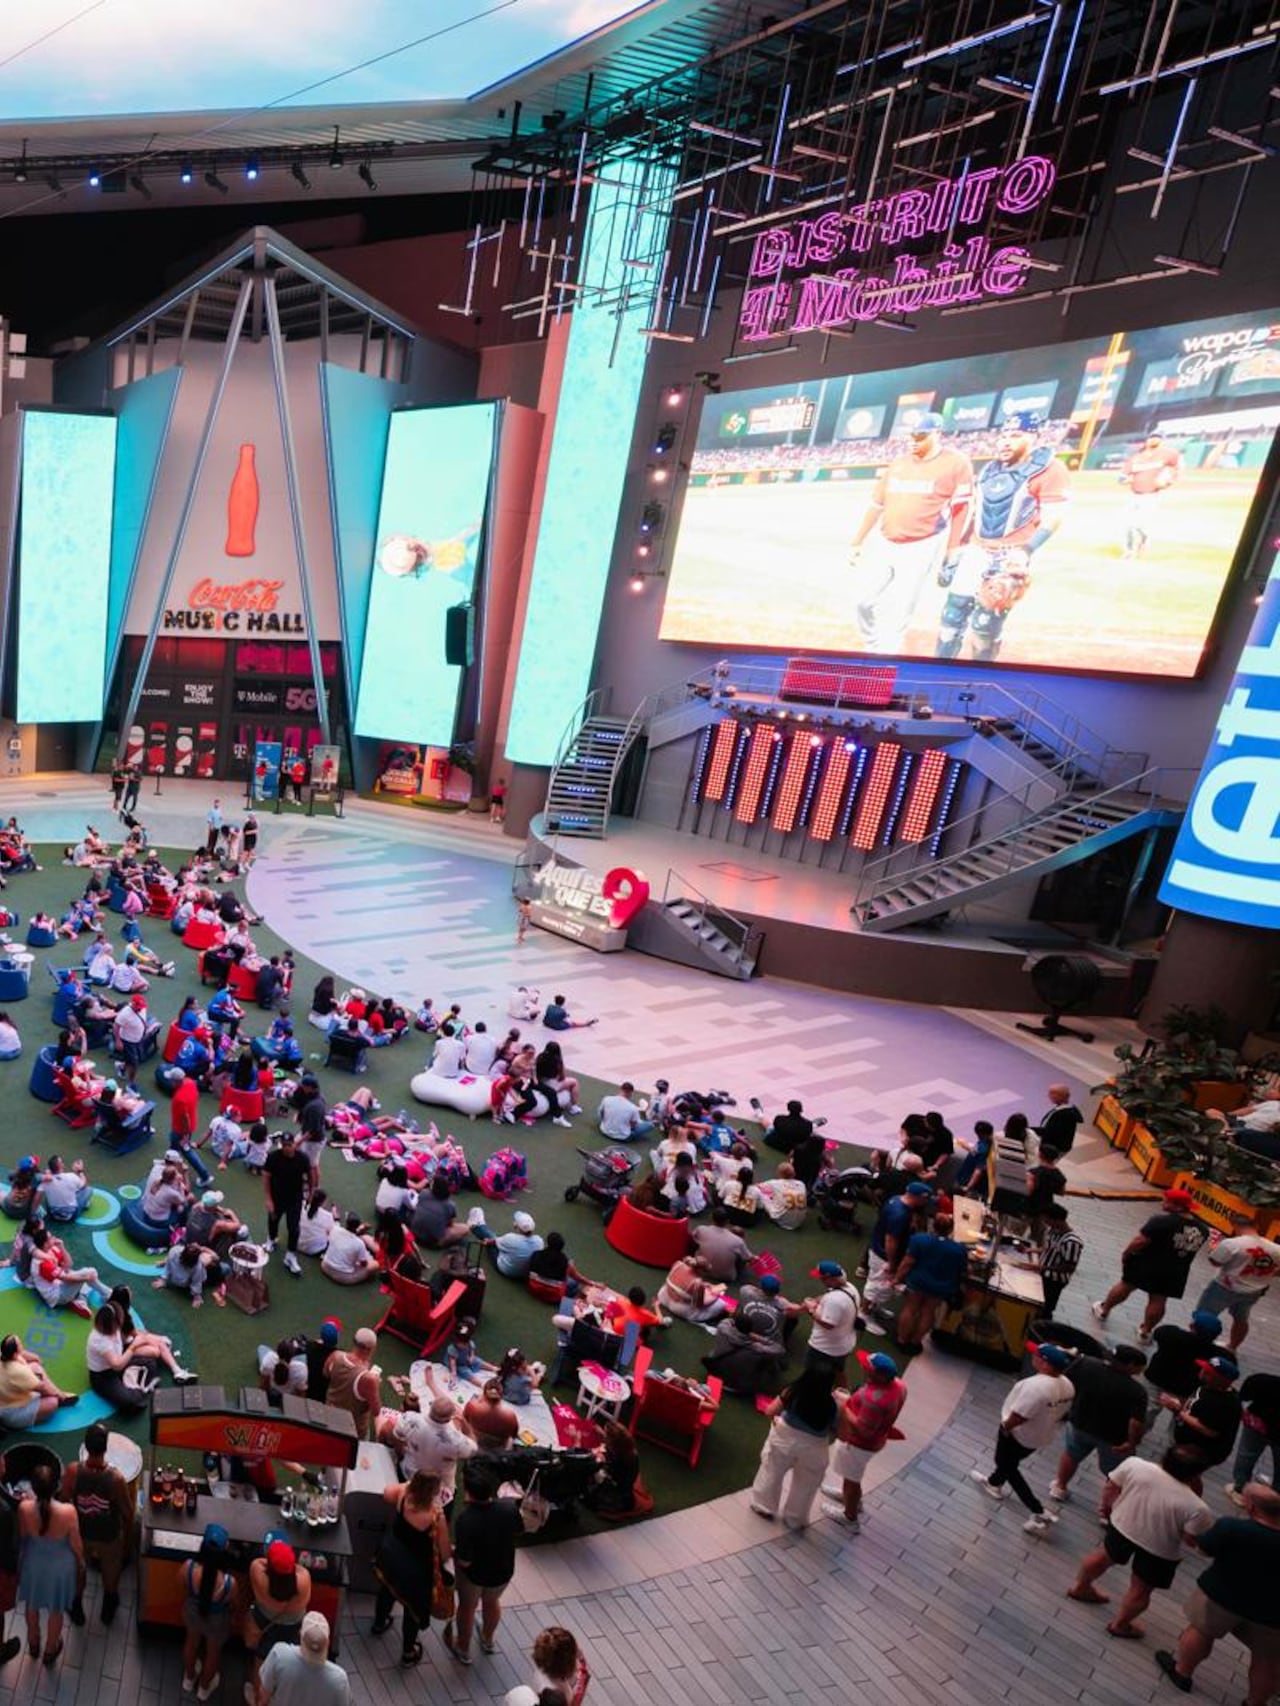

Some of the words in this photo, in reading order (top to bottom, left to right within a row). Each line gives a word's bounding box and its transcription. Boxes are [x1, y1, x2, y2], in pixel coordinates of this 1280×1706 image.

[750, 155, 1057, 278] DISTRITO
[1183, 329, 1254, 353] wapa
[164, 610, 240, 632] MUSIC
[247, 611, 305, 633] HALL
[185, 684, 214, 692] ENJOY
[285, 688, 318, 711] 5G
[555, 886, 593, 910] QUE
